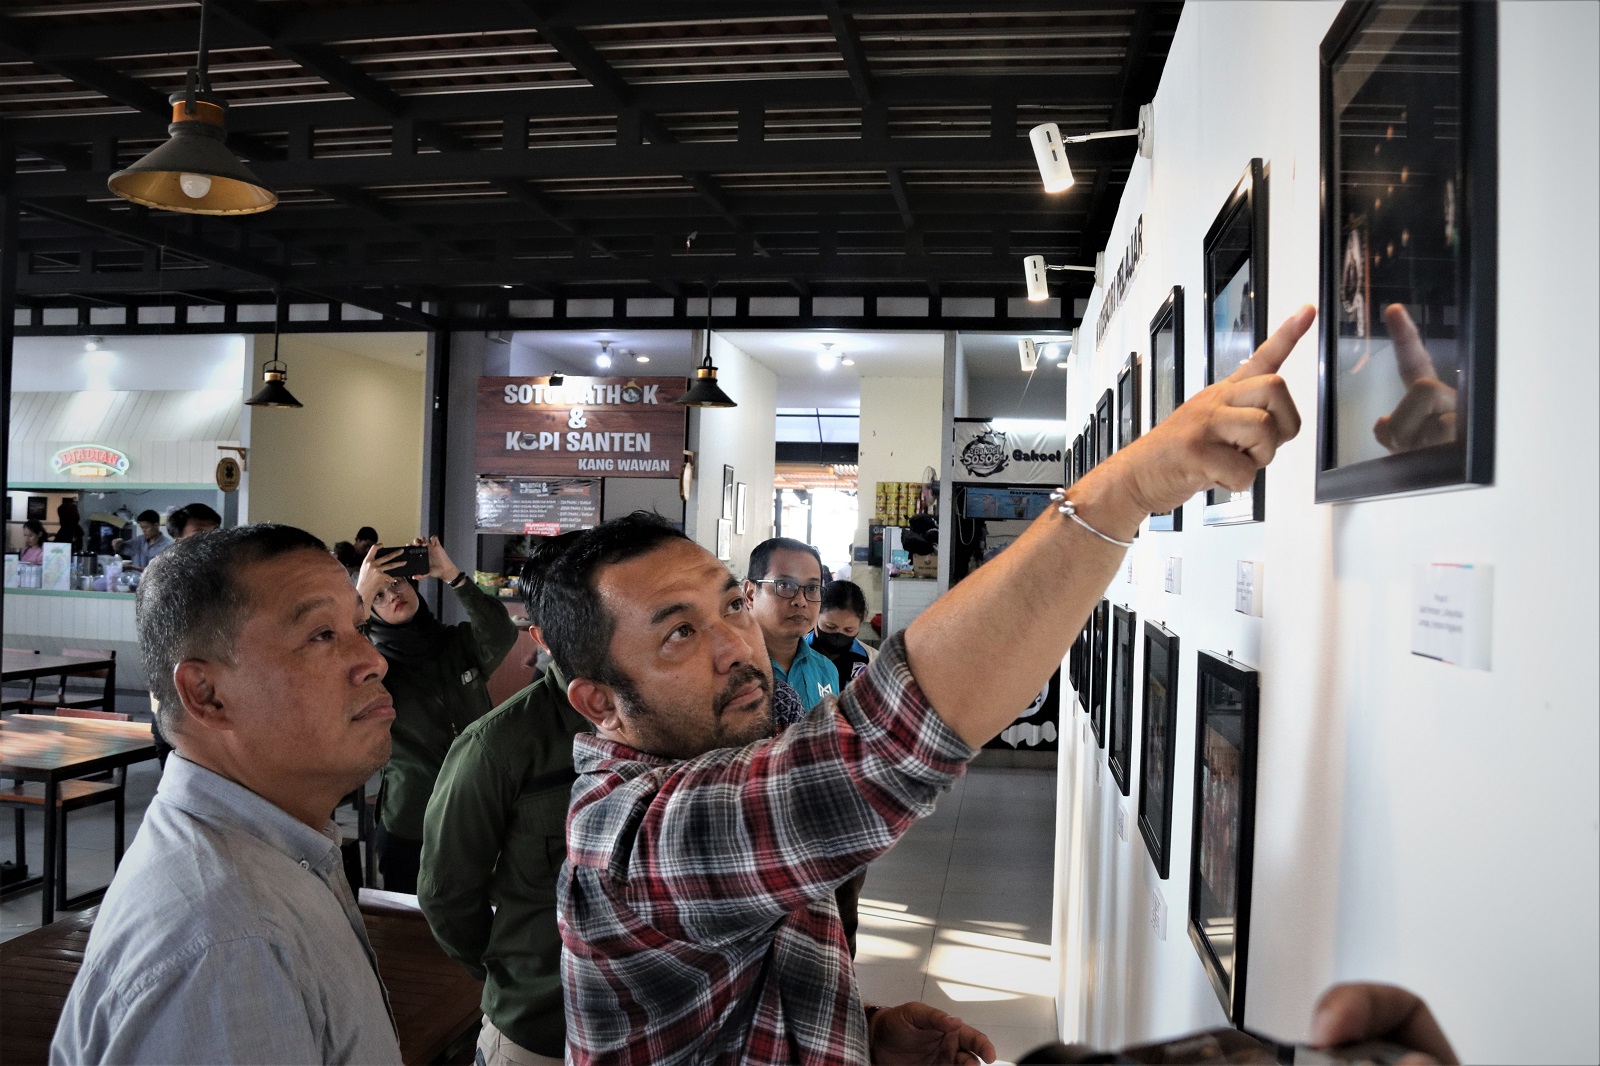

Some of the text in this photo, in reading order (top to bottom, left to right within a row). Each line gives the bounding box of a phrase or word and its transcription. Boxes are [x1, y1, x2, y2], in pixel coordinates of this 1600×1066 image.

[568, 407, 587, 429] &
[566, 431, 650, 452] SANTEN
[60, 448, 120, 465] DJADJAN
[1012, 449, 1061, 462] Bakoel
[578, 458, 670, 472] KANG WAWAN
